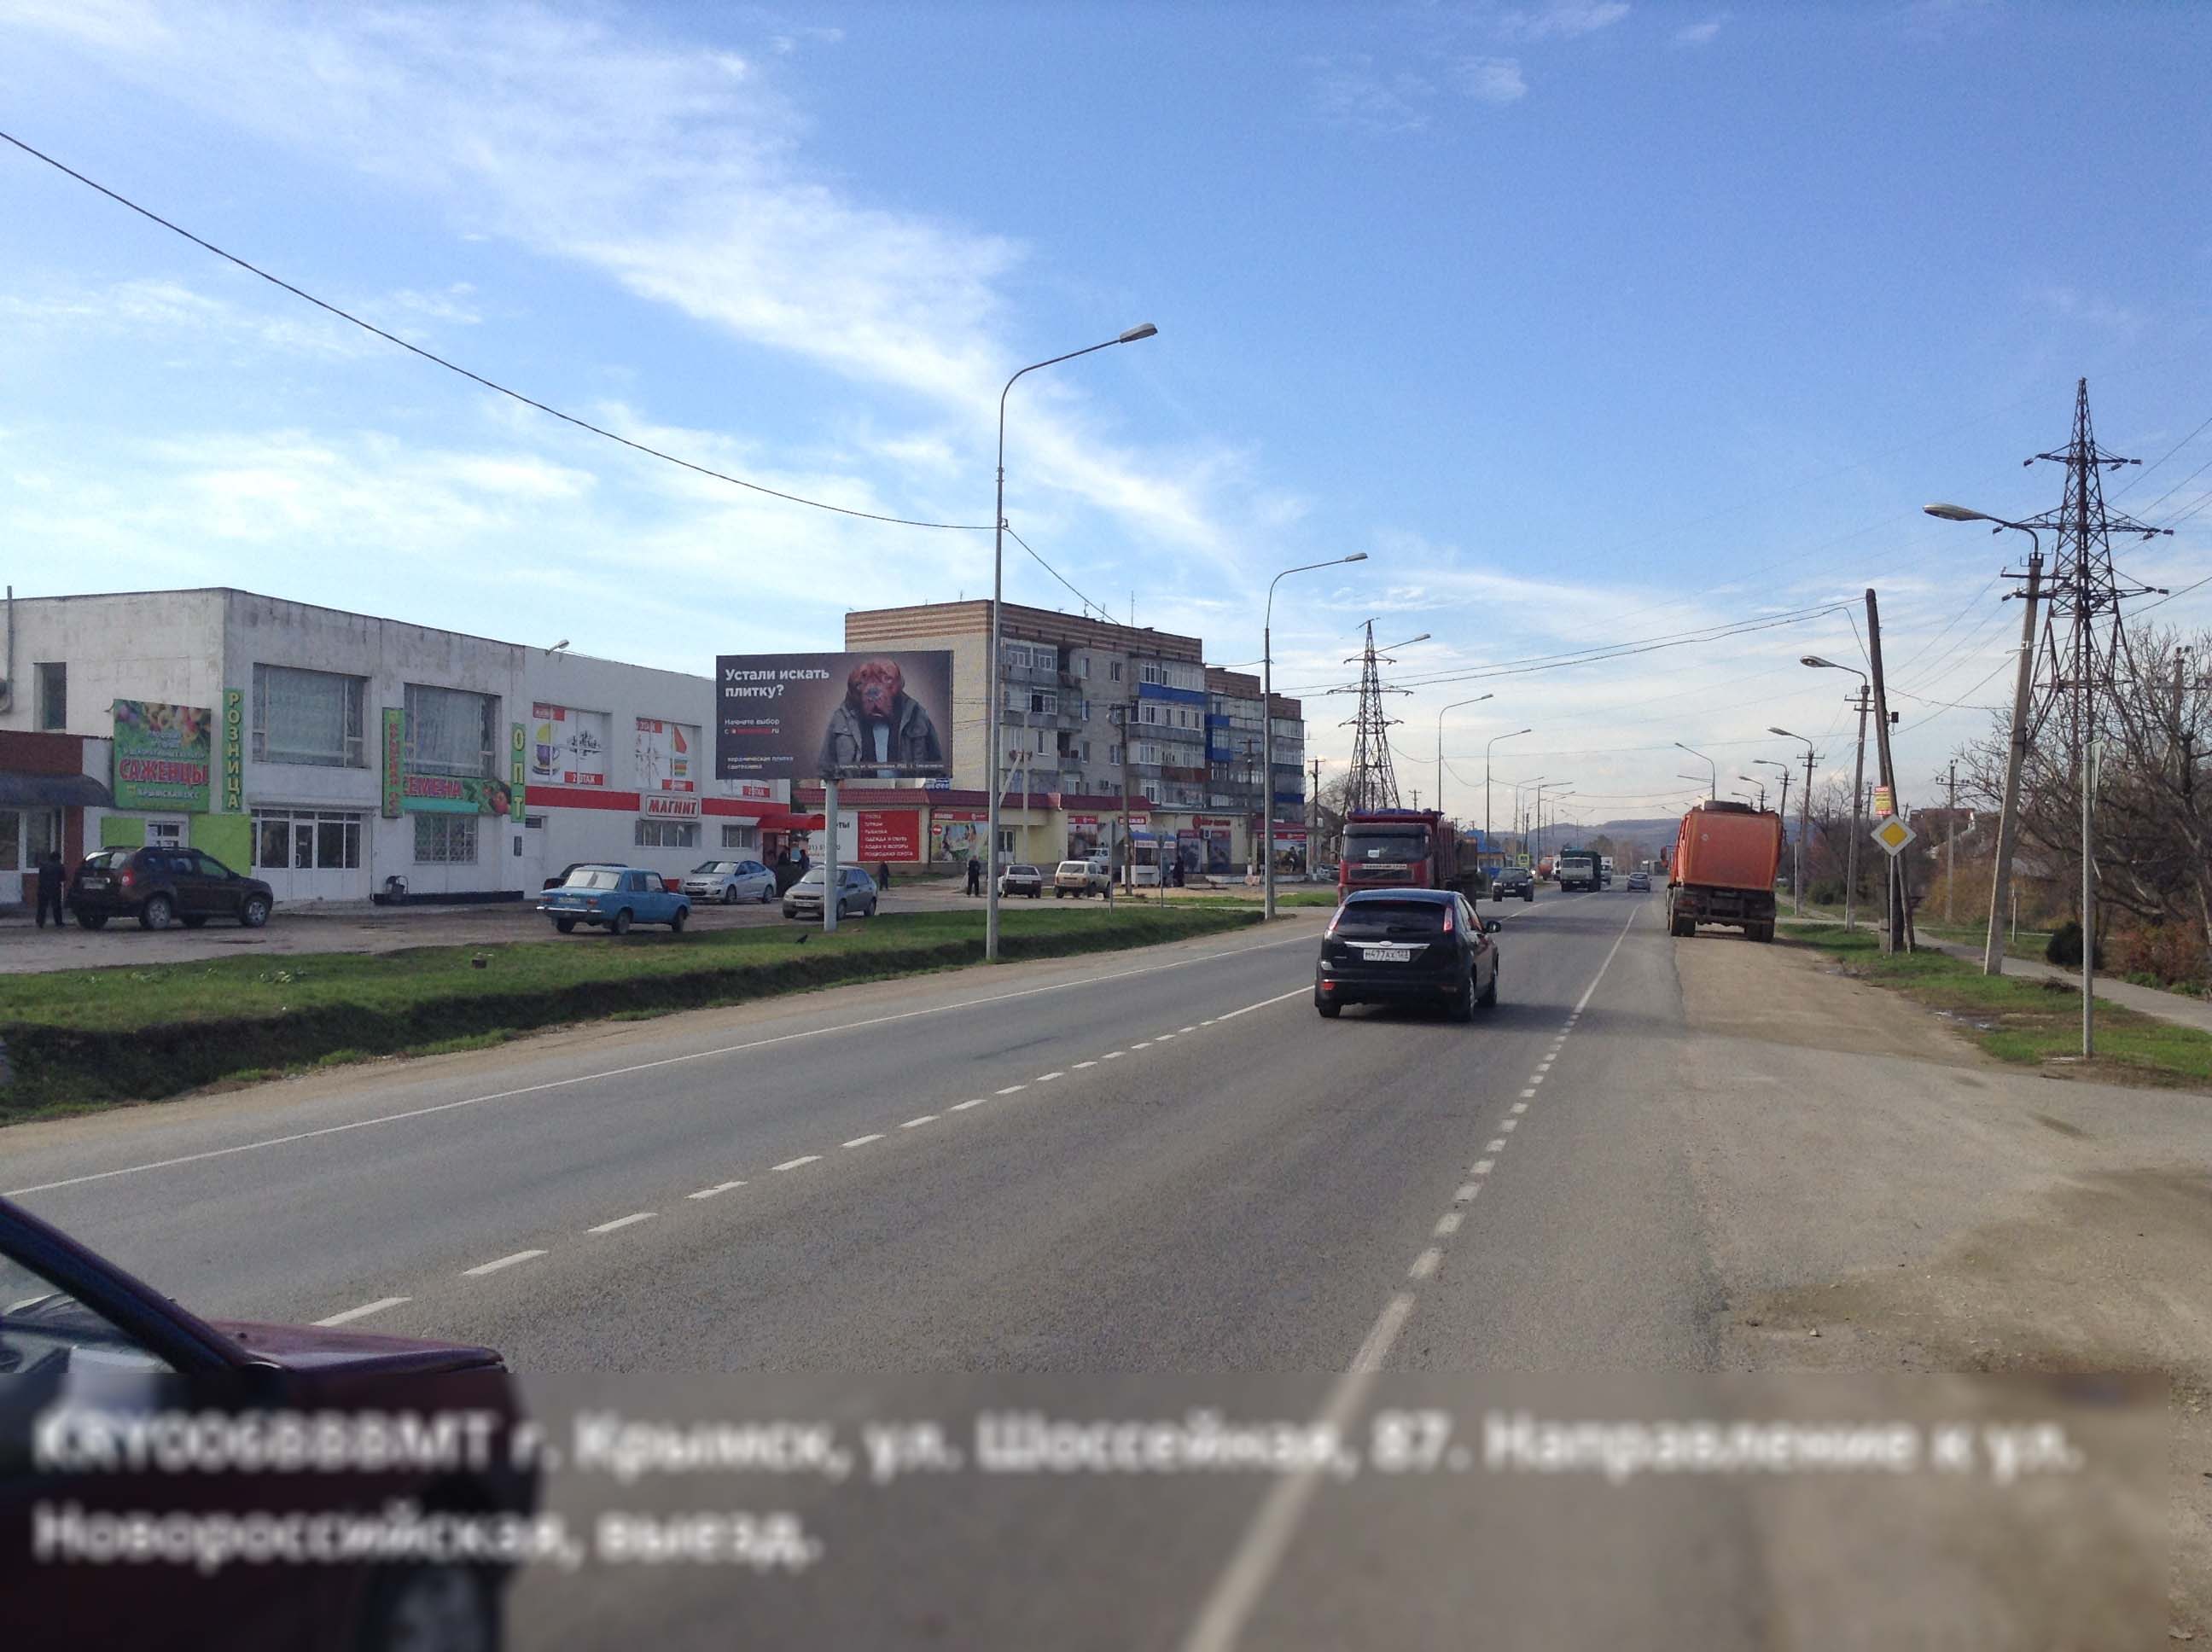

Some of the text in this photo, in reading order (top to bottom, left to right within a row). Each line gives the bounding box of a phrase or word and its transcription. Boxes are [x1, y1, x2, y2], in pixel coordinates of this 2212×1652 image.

[725, 669, 830, 680] Устали искать
[725, 684, 784, 699] плитку?
[227, 691, 241, 809] РОЗНИЦА
[119, 759, 210, 788] САЖЕНЦЫ
[513, 728, 526, 819] ОПТ
[648, 798, 697, 815] МАГНИТ
